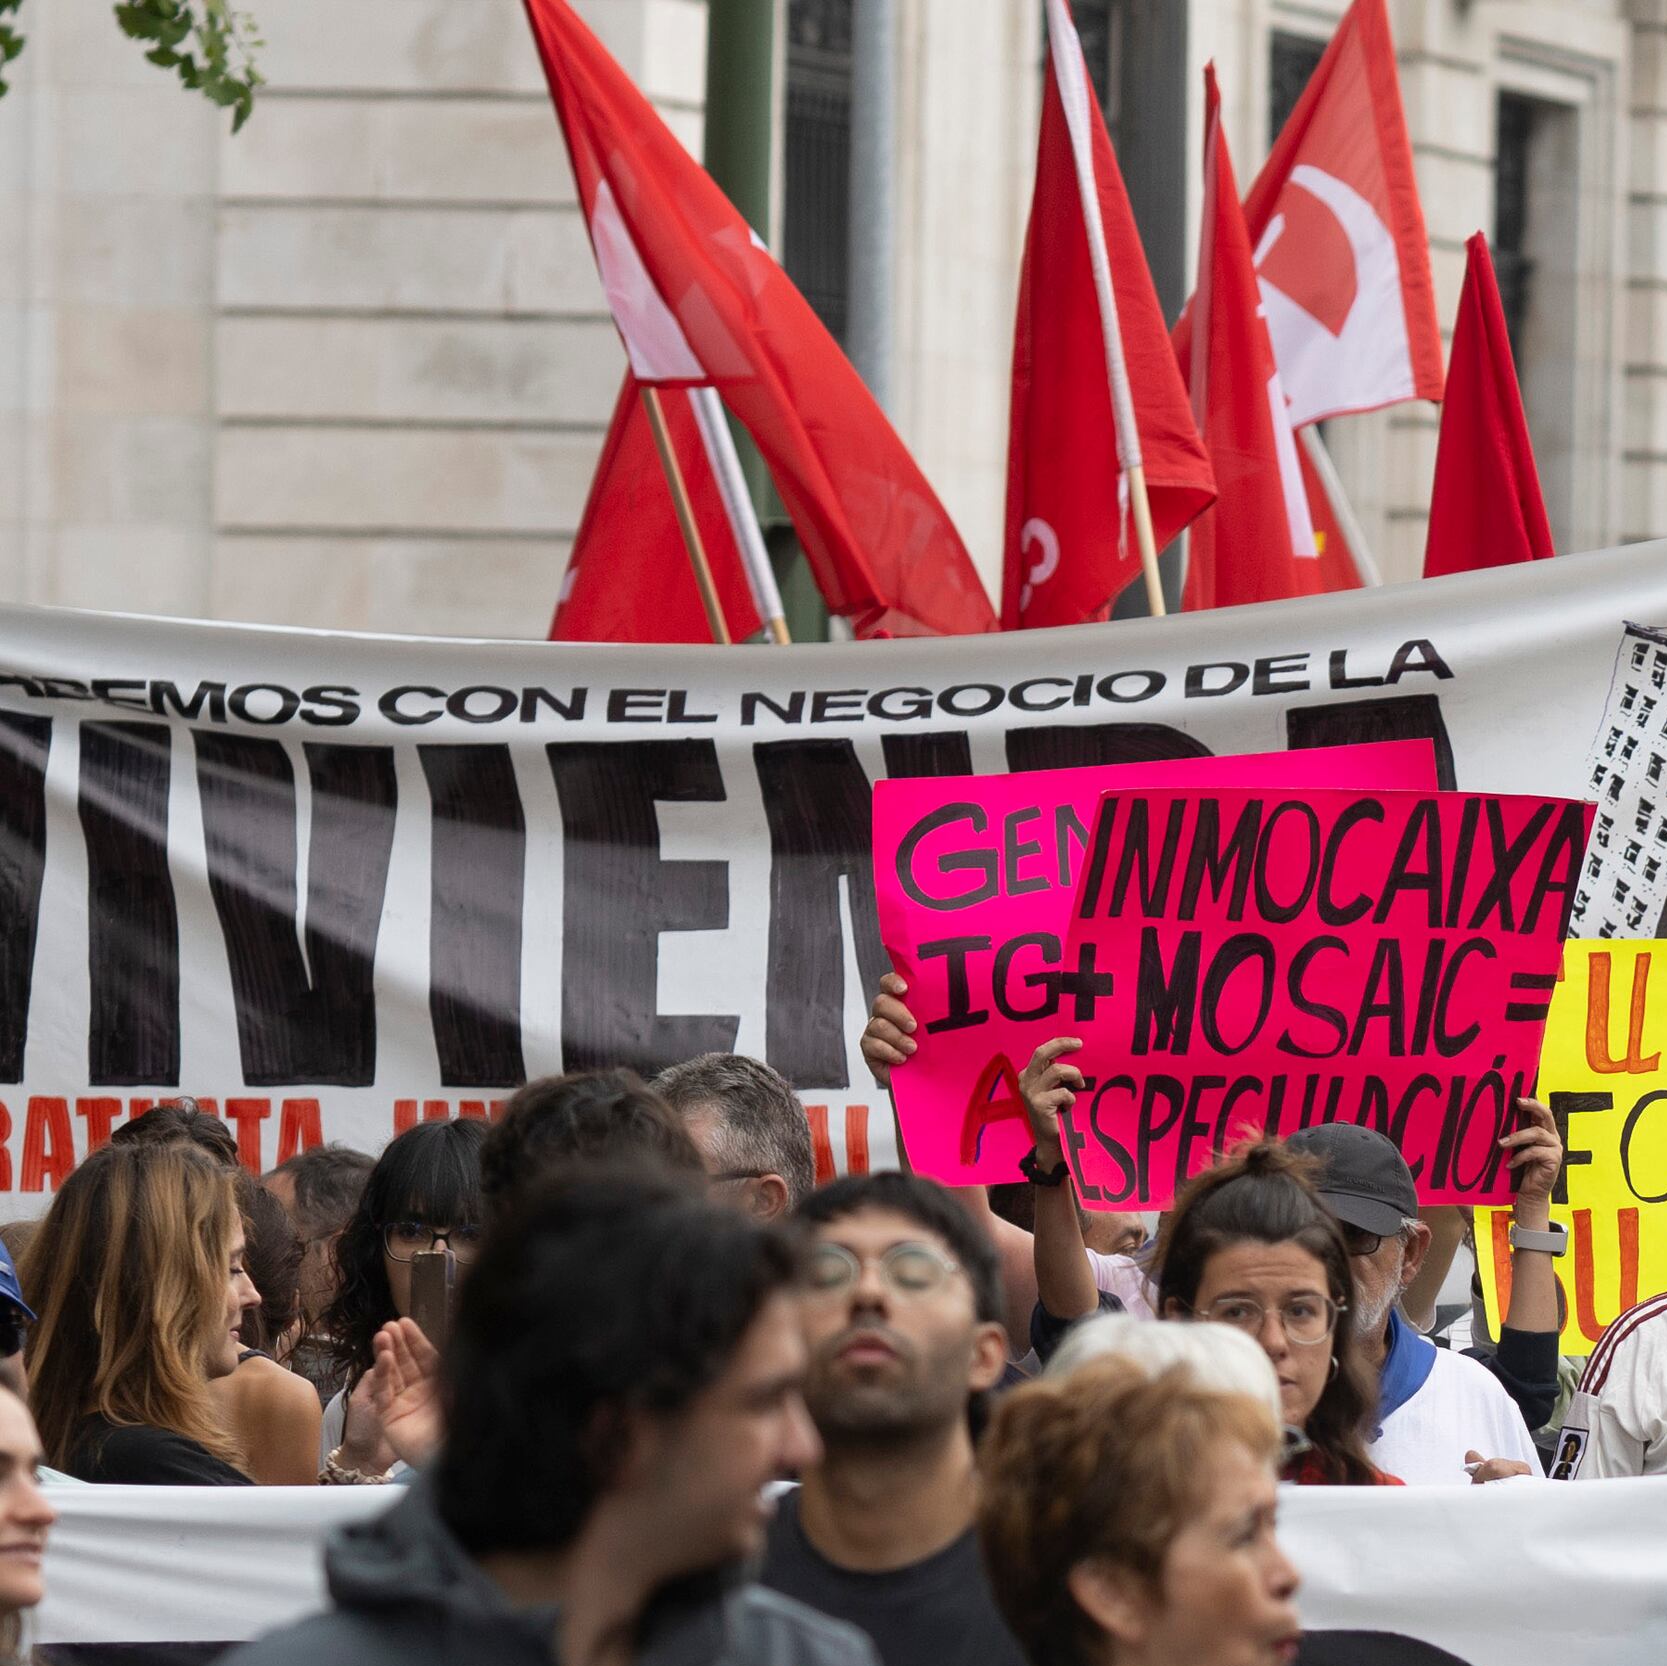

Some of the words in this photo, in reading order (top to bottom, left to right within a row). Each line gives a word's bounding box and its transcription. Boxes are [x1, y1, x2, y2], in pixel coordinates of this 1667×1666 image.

[377, 686, 588, 726] CON
[607, 690, 717, 724] EL
[740, 670, 1167, 724] NEGOCIO
[1185, 653, 1309, 698] DE
[1328, 639, 1455, 687] LA
[1078, 796, 1586, 943] INMOCAIXA
[1131, 926, 1497, 1058] MOSAIC
